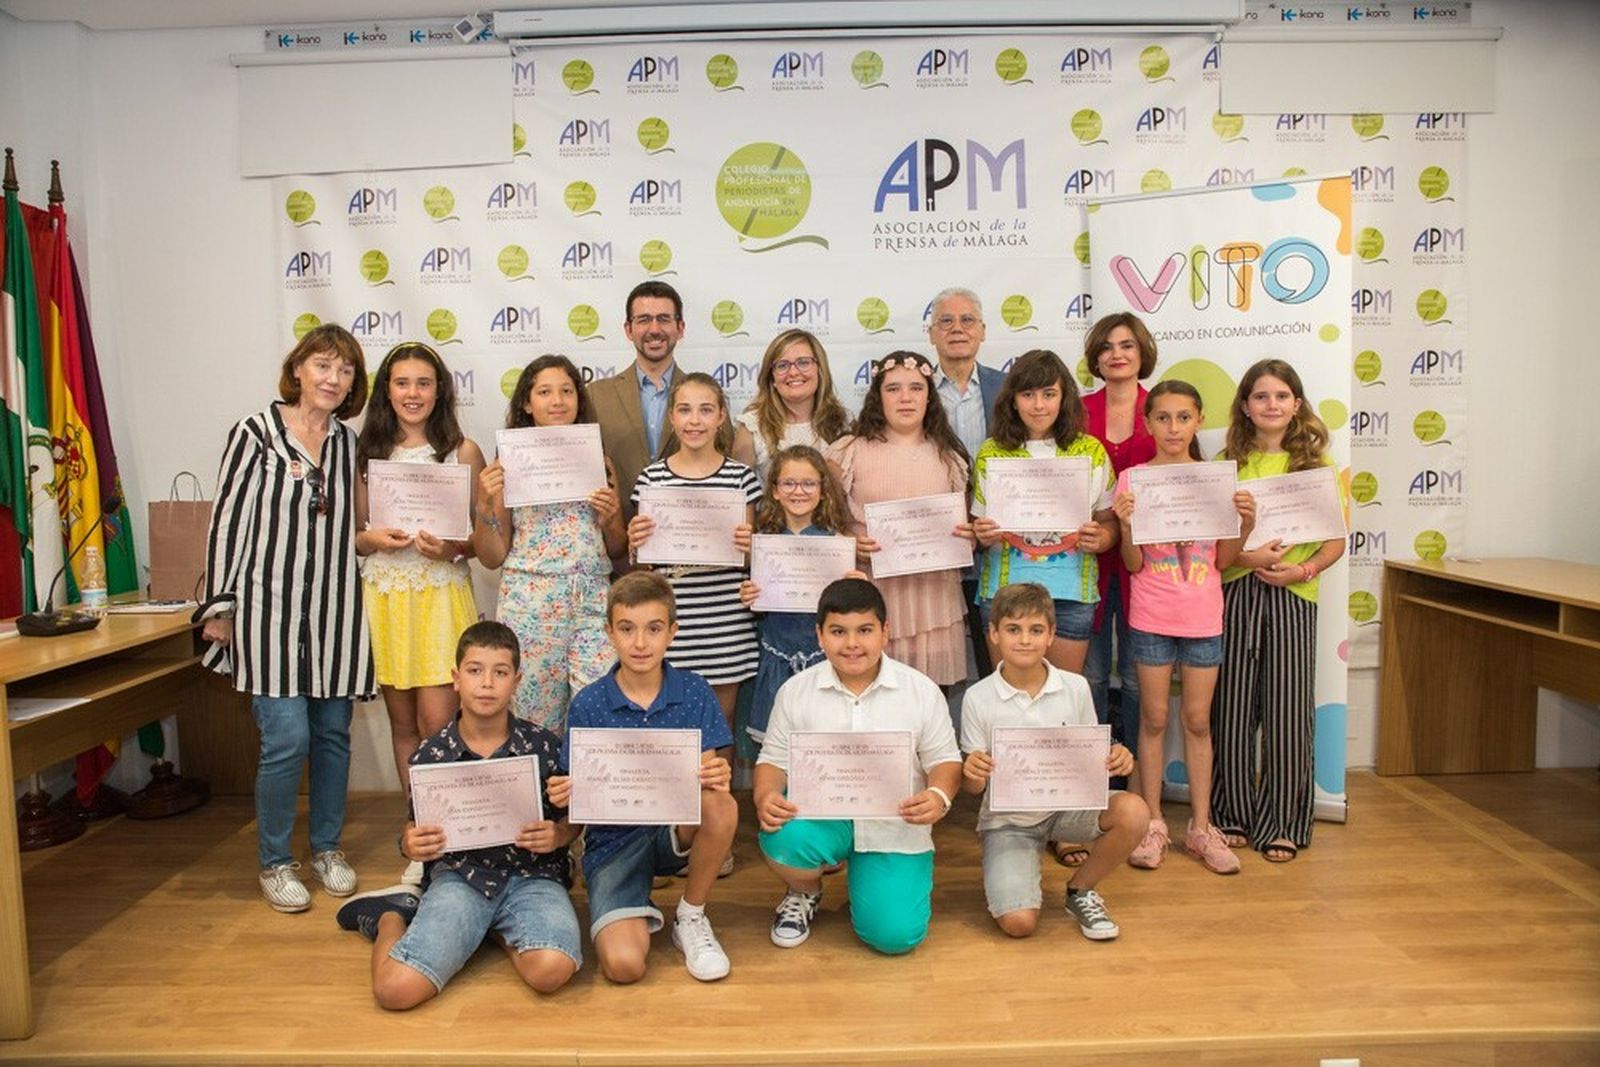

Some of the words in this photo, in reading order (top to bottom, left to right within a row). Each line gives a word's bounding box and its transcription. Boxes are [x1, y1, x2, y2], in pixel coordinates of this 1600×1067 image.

[628, 56, 679, 82] APM
[772, 51, 824, 78] APM
[916, 49, 968, 75] APM
[1061, 48, 1112, 71] APM
[1136, 106, 1187, 131] APM
[1276, 113, 1326, 130] APM
[1416, 113, 1465, 129] APM
[559, 119, 611, 145] APM
[723, 165, 769, 174] COLEGIO
[724, 175, 793, 185] PROFESIONAL
[873, 138, 1027, 213] APM
[1064, 169, 1115, 194] APM
[348, 188, 396, 214] APM
[487, 182, 537, 208] APM
[630, 179, 681, 204] APM
[724, 187, 786, 196] PERIODISTAS
[873, 220, 980, 235] ASOCIACIÓN
[989, 219, 1006, 231] de
[1015, 218, 1029, 230] la
[874, 236, 938, 253] PRENSA
[942, 236, 959, 248] de
[963, 233, 1029, 247] MÁLAGA
[1413, 228, 1464, 252] APM
[286, 251, 331, 277] APM
[420, 247, 471, 272] APM
[562, 242, 613, 268] APM
[1109, 237, 1330, 314] VITO
[777, 299, 829, 324] APM
[1066, 293, 1092, 319] AP
[351, 310, 402, 335] APM
[490, 306, 540, 332] APM
[1155, 329, 1194, 343] CANDO
[1197, 327, 1212, 340] EN
[1215, 321, 1312, 338] COMUNICACIÓN
[1410, 350, 1462, 375] APM
[579, 366, 616, 386] PM
[1408, 470, 1461, 495] APM
[1349, 531, 1386, 556] PM
